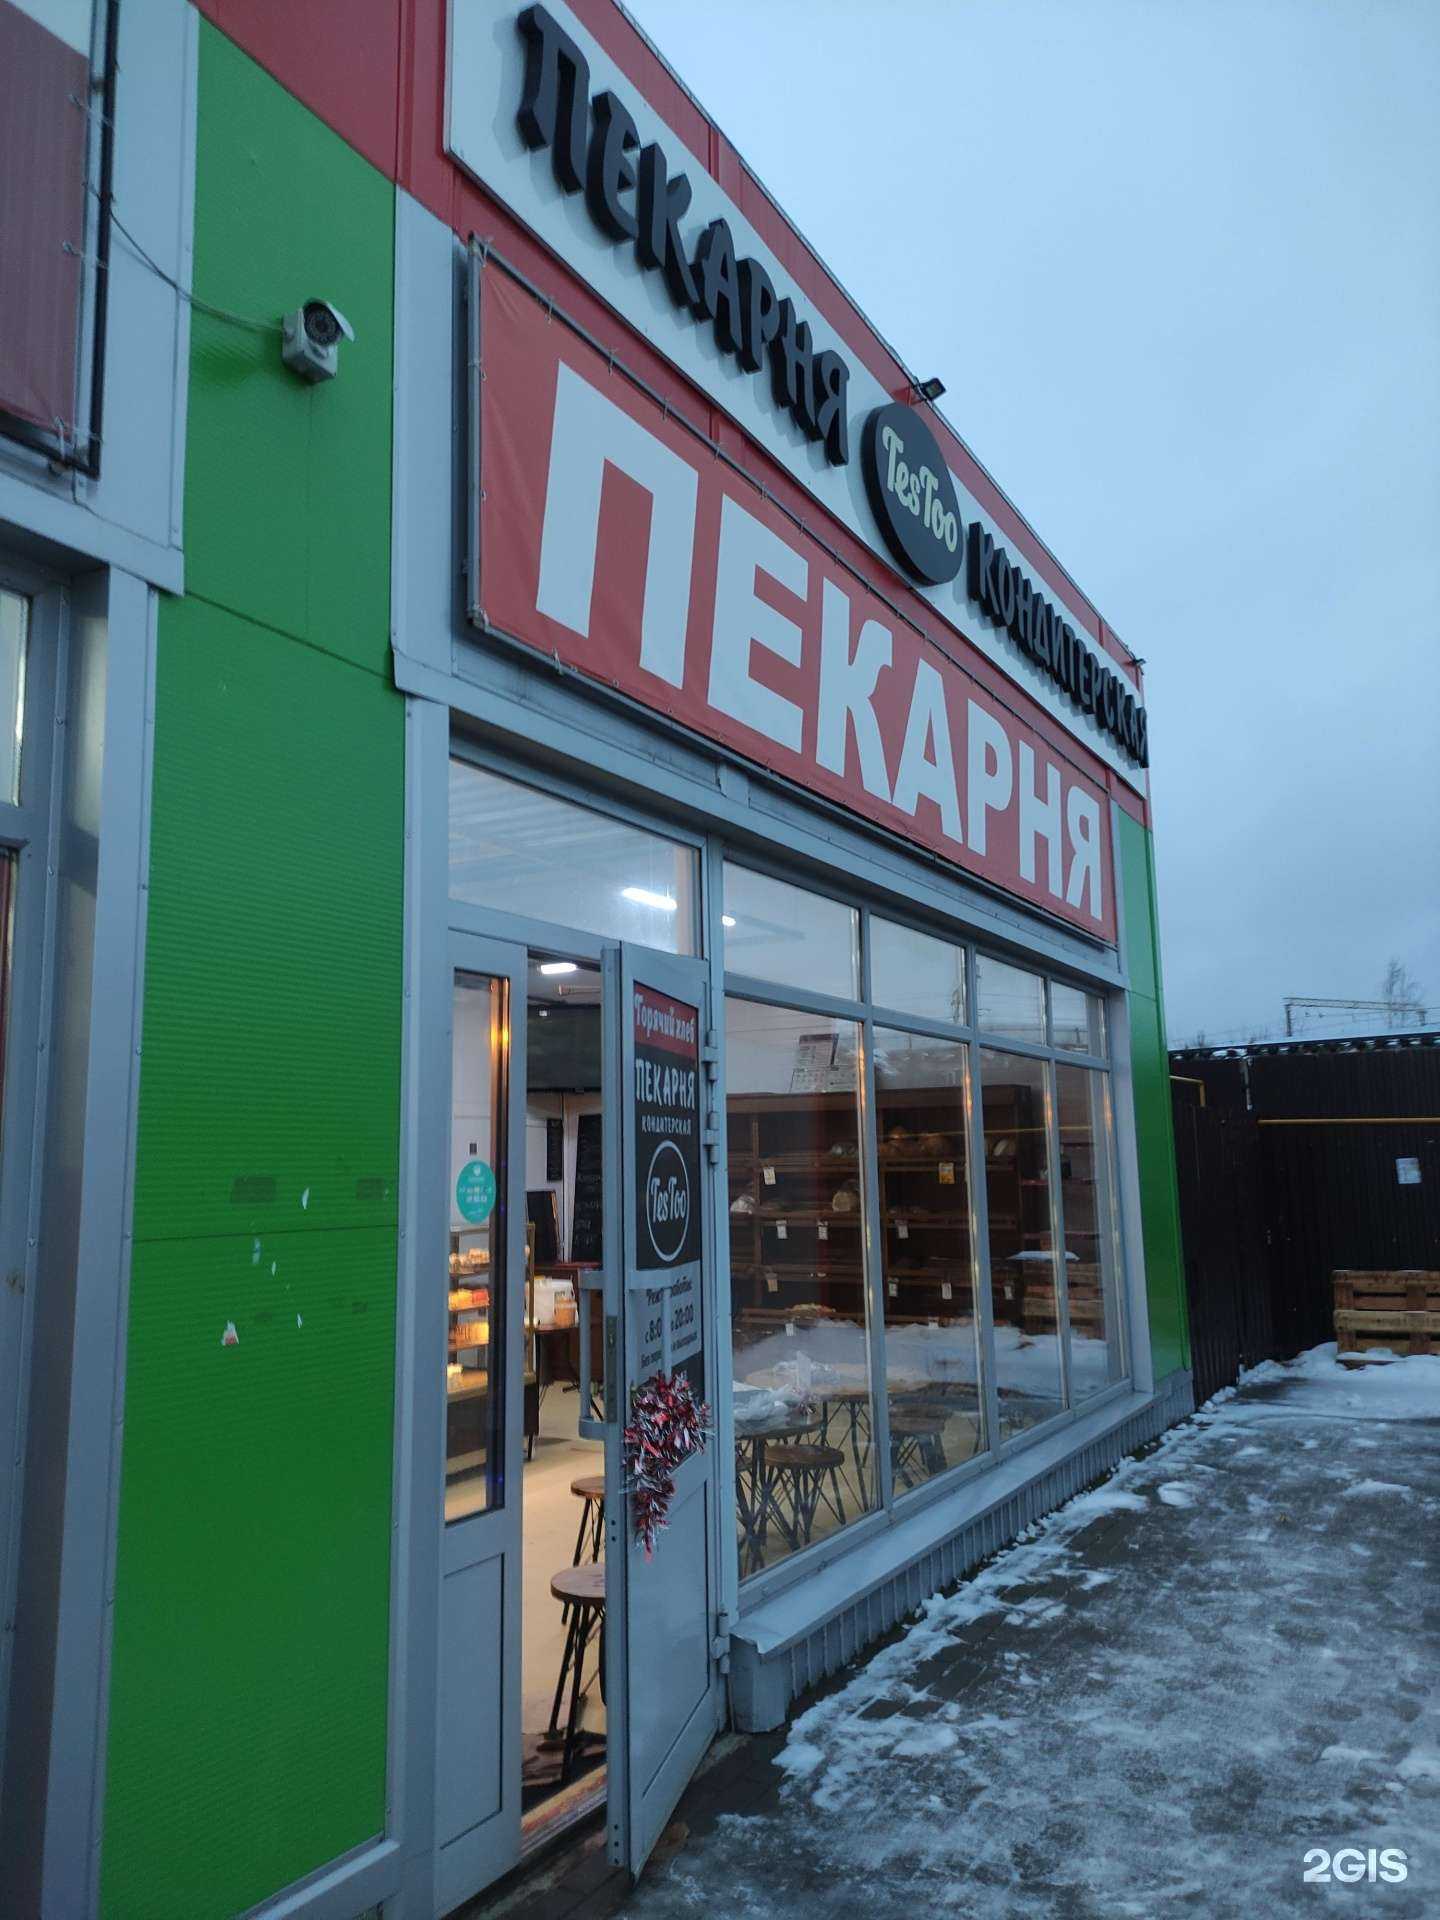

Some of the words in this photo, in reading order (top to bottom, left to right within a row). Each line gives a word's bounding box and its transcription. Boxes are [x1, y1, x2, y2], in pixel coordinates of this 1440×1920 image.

[517, 3, 849, 467] ПЕКАРНЯ
[882, 426, 957, 552] TesToo
[968, 522, 1149, 769] КОНДИТЕРСКАЯ
[535, 358, 1103, 922] ПЕКАРНЯ
[635, 994, 674, 1038] Горячий
[675, 1016, 695, 1044] хлеб
[635, 1058, 695, 1110] ПЕКАРНЯ
[651, 1177, 686, 1222] TesToo
[649, 1317, 662, 1342] 8:0
